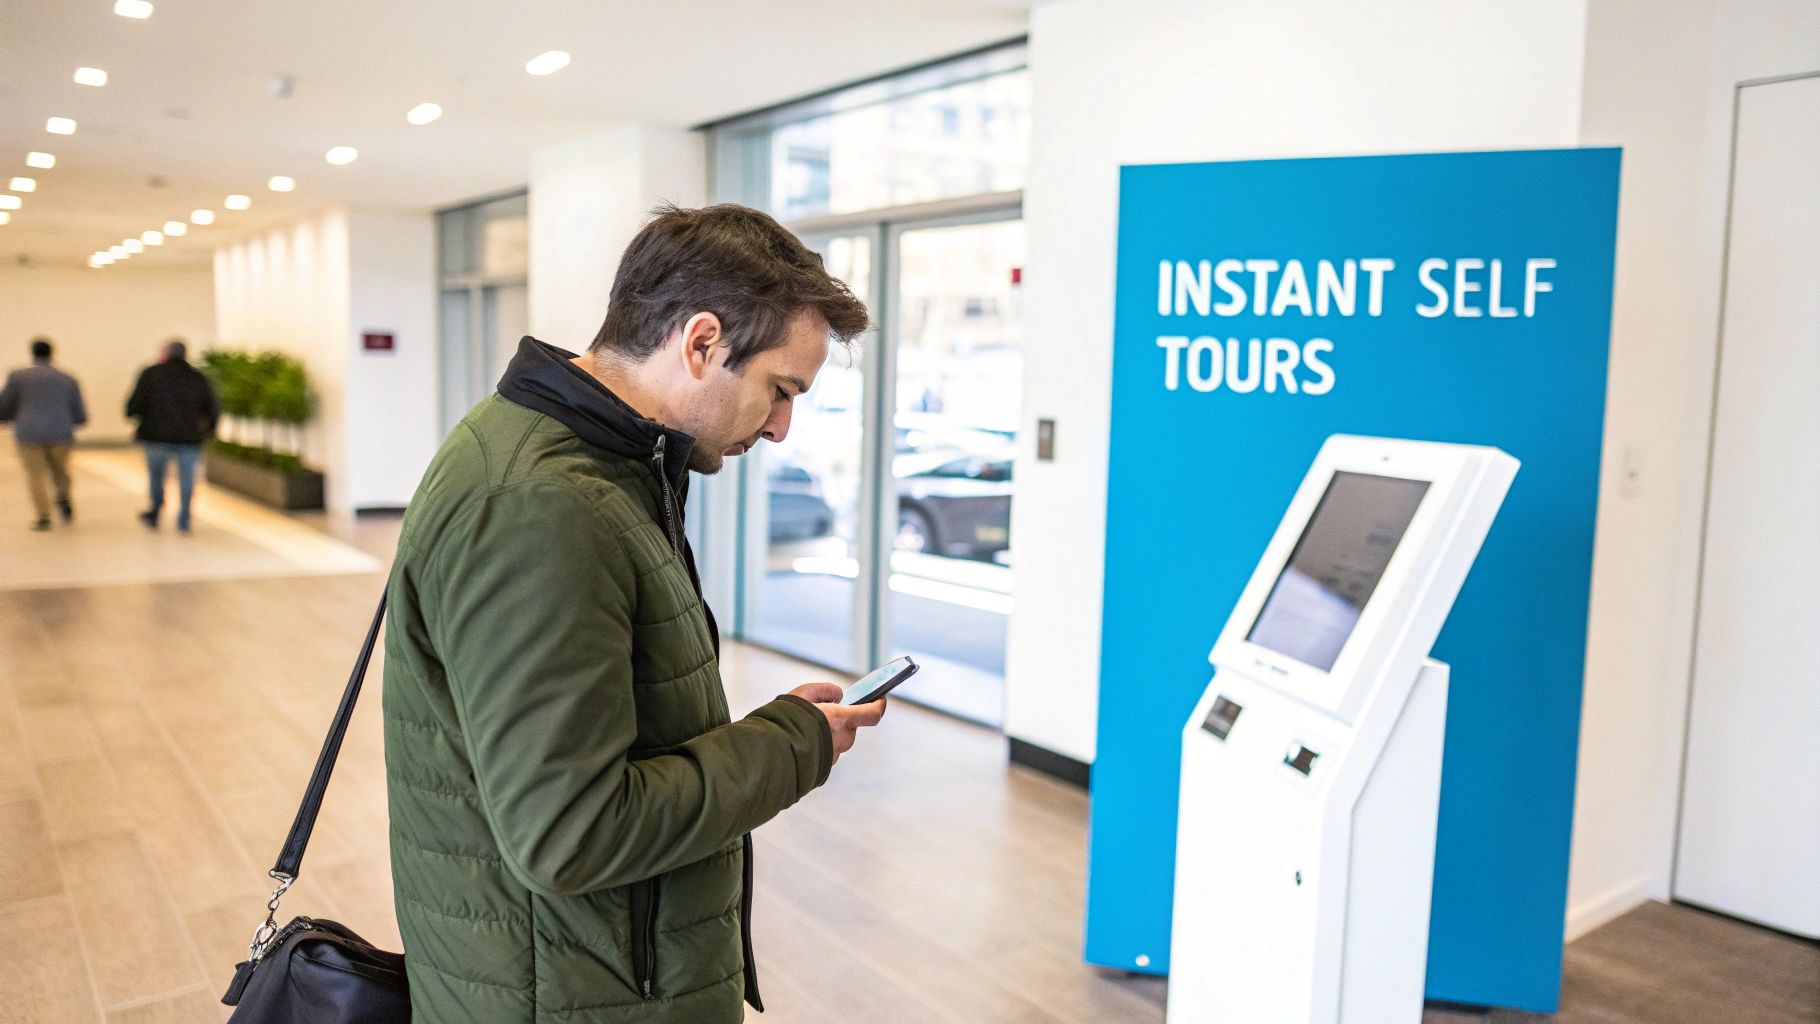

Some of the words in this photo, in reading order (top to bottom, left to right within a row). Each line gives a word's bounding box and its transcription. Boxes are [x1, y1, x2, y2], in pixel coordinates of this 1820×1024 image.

[1158, 259, 1394, 316] INSTANT
[1416, 258, 1556, 317] SELF
[1157, 336, 1335, 395] TOURS
